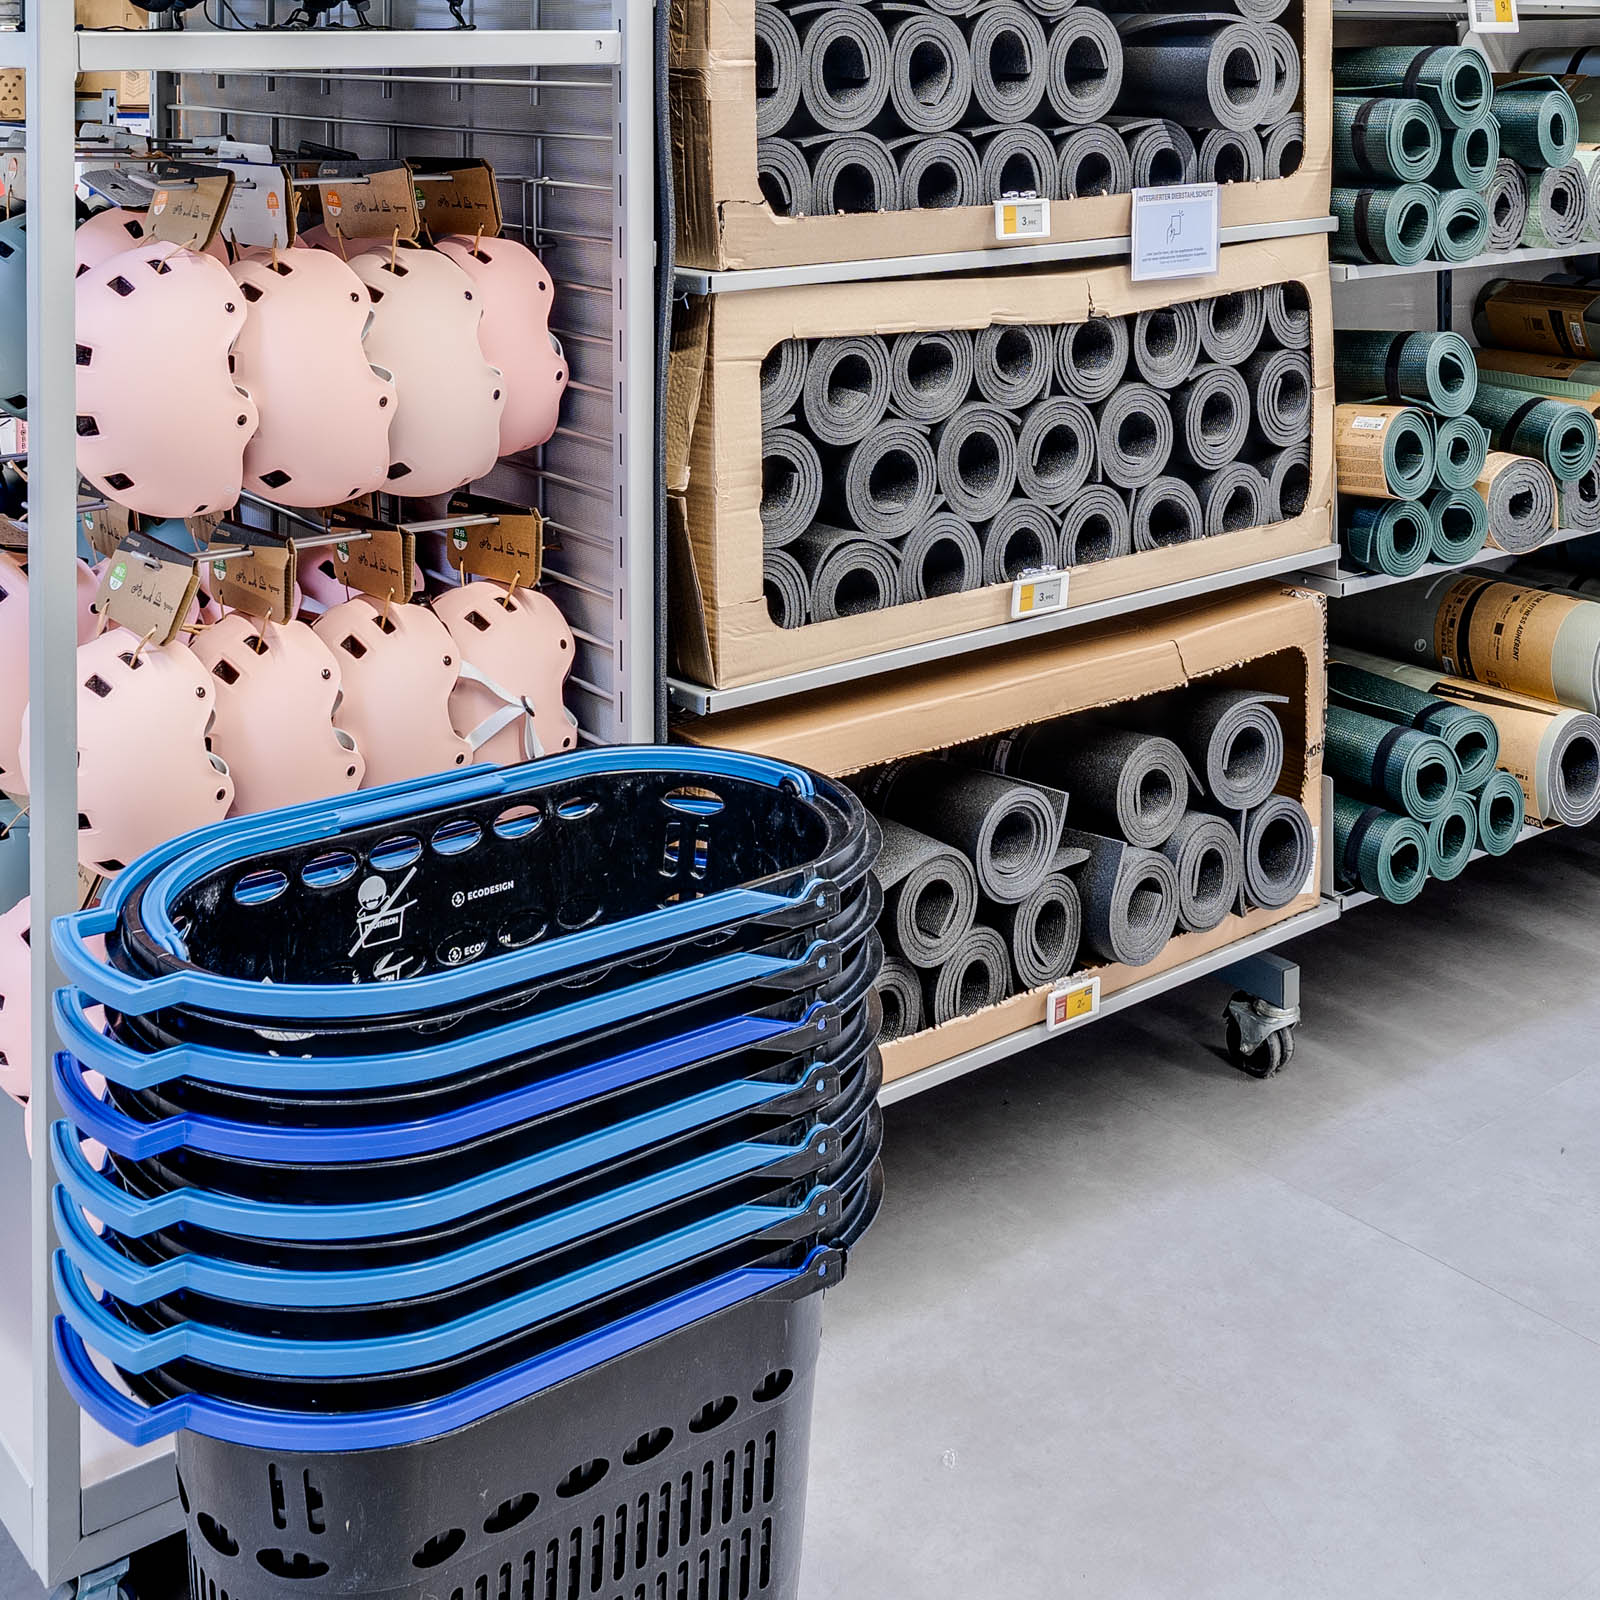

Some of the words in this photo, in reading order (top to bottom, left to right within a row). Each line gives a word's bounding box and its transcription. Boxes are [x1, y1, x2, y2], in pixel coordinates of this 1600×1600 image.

[1520, 602, 1538, 625] FITNESS
[1512, 624, 1524, 662] ADHÉRENT
[467, 880, 514, 901] ECODESIGN
